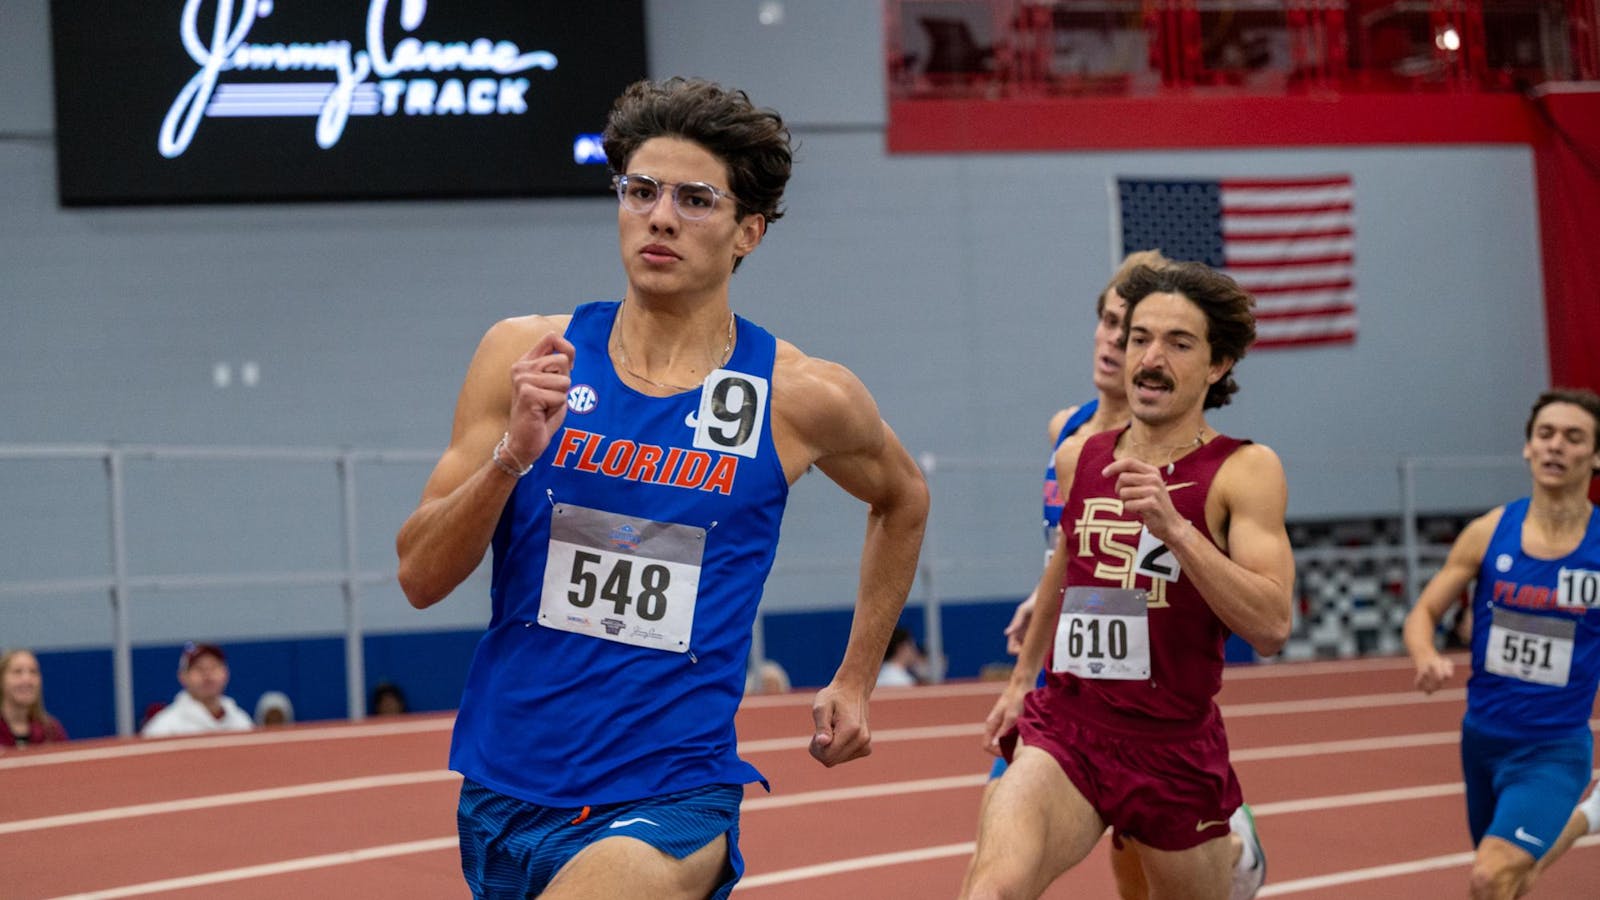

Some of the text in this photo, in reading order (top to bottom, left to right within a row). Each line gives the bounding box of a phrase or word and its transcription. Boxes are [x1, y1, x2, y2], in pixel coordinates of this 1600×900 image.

[378, 77, 530, 116] TRACK
[567, 385, 596, 412] SEC
[708, 377, 758, 447] 9
[552, 427, 739, 496] FLORIDA
[567, 550, 671, 621] 548
[1562, 573, 1597, 604] 10
[1068, 617, 1128, 660] 610
[1502, 634, 1553, 670] 551
